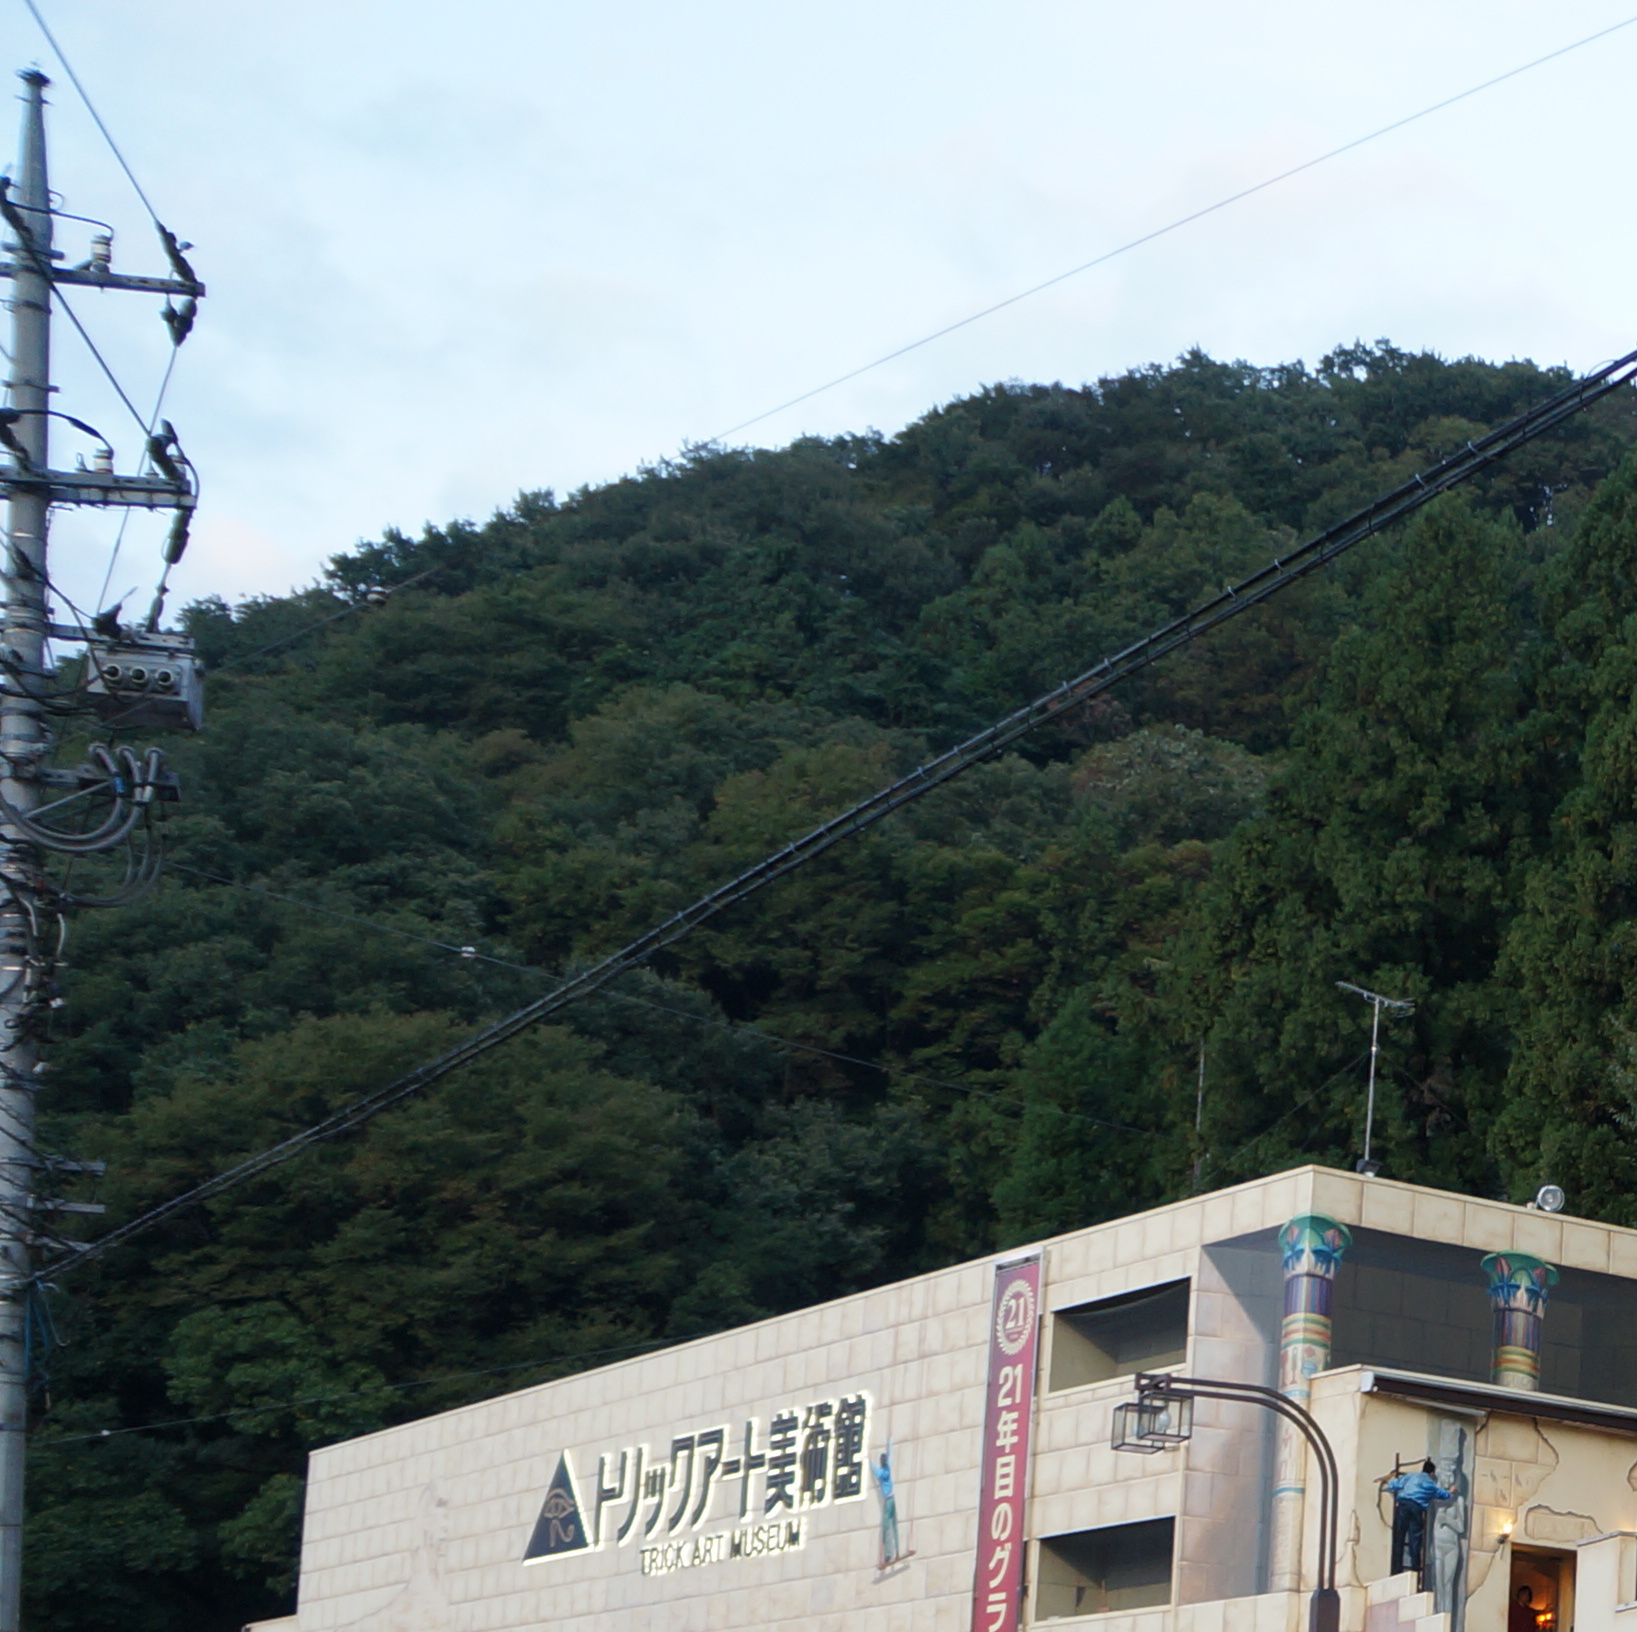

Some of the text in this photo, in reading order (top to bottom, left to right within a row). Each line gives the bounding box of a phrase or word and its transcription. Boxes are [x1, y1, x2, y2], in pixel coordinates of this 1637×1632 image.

[1005, 1297, 1025, 1330] 21
[594, 1391, 871, 1552] トリックアート美術館
[639, 1521, 802, 1576] TRICK ART MUSEUM
